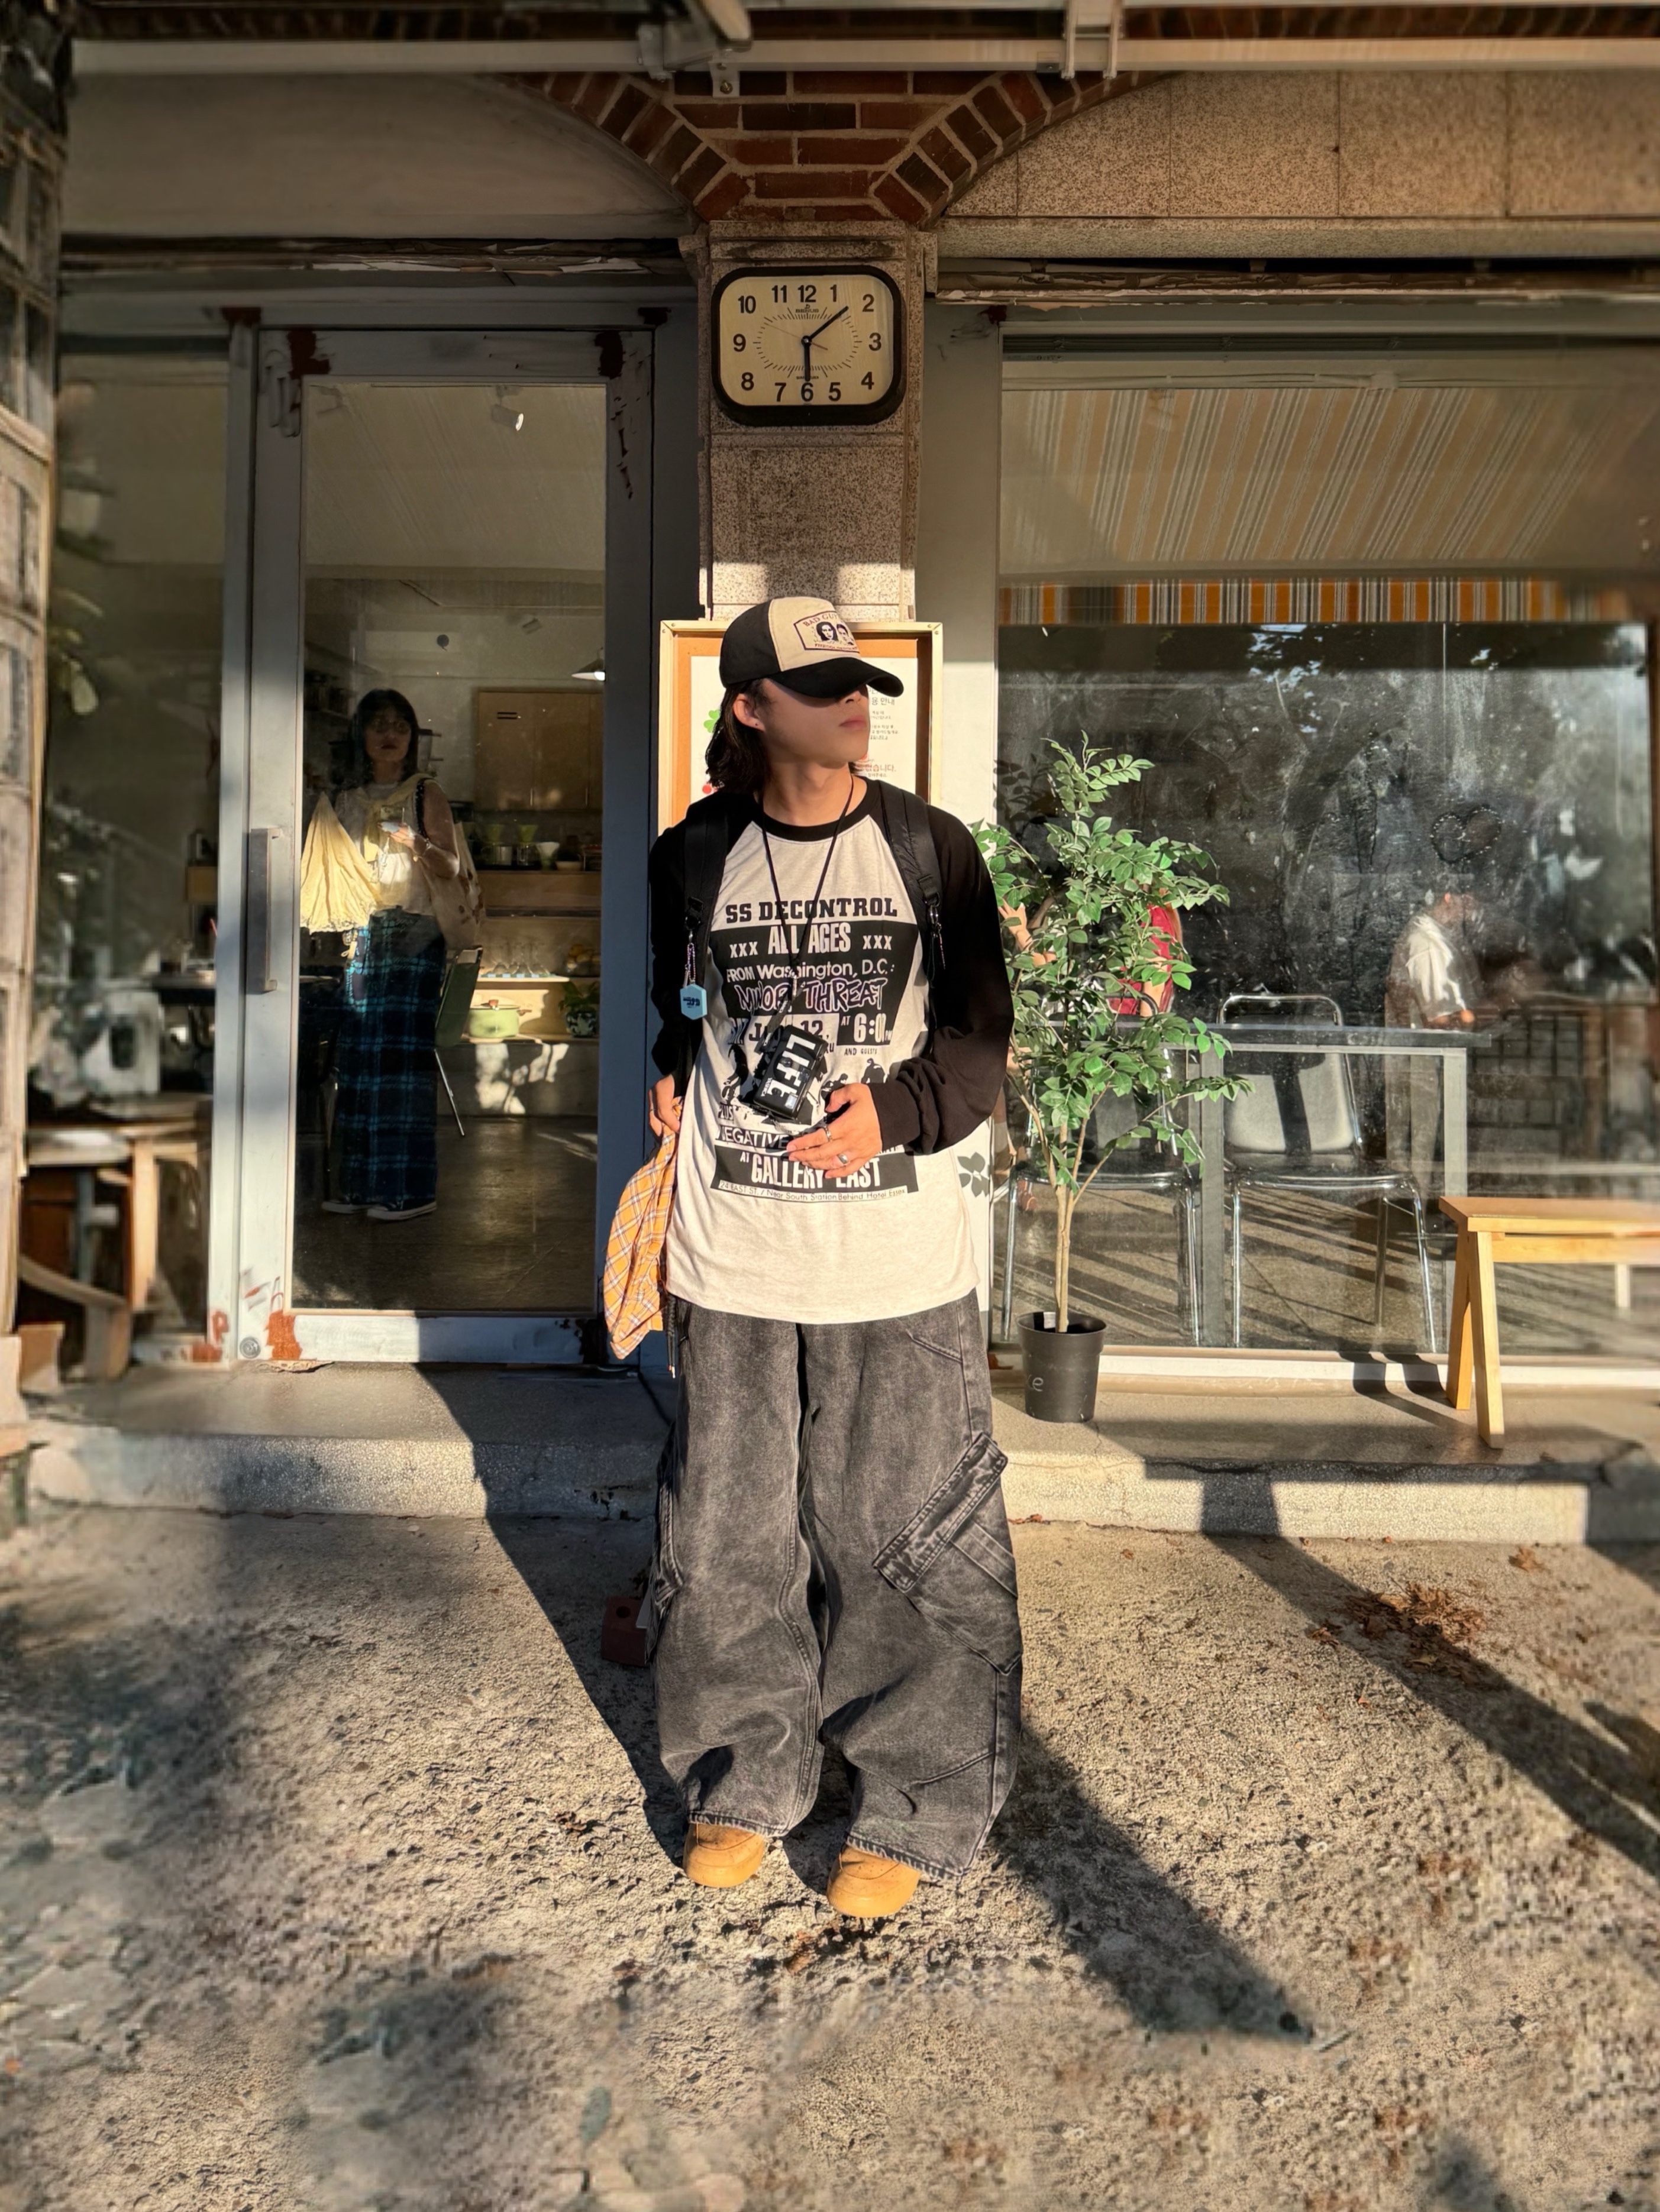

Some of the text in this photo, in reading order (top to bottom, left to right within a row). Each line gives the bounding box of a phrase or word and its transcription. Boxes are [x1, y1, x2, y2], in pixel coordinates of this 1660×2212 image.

[771, 284, 787, 303] 11
[797, 284, 816, 303] 12
[829, 284, 837, 302] 1
[738, 295, 757, 314] 10
[862, 294, 875, 312] 2
[733, 333, 746, 352] 9
[868, 332, 882, 351] 3
[741, 372, 754, 391] 8
[861, 371, 874, 390] 4
[774, 382, 787, 402] 7
[801, 382, 813, 402] 6
[828, 382, 841, 402] 5
[802, 617, 821, 627] BAD
[725, 897, 897, 924] SS DECONTROL
[768, 925, 800, 955] ALL
[808, 922, 851, 954] AGES
[726, 966, 755, 982] FROM
[803, 977, 888, 1013] THREAT
[841, 1015, 851, 1026] AT
[844, 1047, 857, 1056] AND
[740, 1151, 750, 1163] AT
[731, 1183, 747, 1193] EAST
[766, 1189, 784, 1199] Near
[786, 1193, 808, 1201] South
[810, 1193, 838, 1201] Station
[867, 1191, 887, 1199] Hotel
